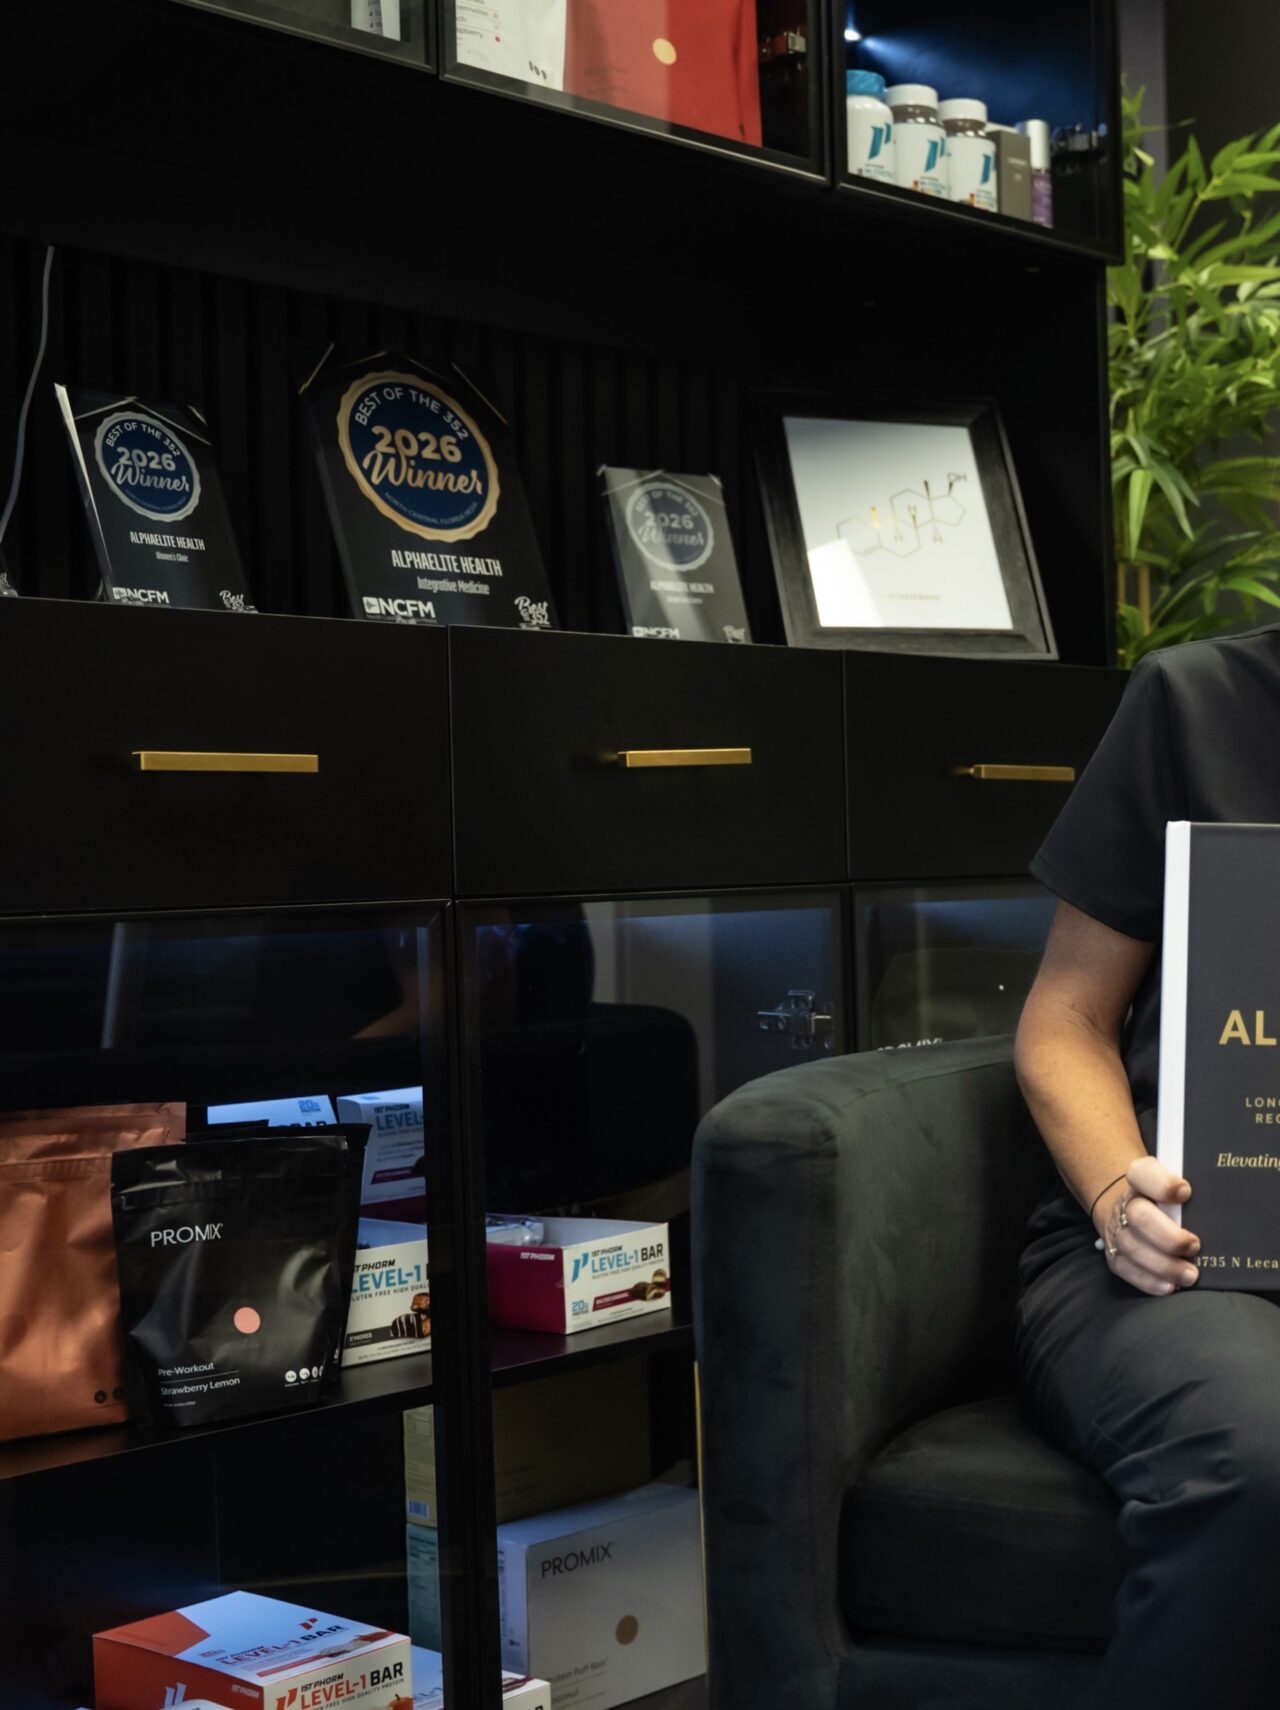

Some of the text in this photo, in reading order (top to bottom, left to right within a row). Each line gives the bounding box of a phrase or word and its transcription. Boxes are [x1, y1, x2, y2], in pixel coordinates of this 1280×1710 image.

[354, 387, 469, 441] BEST OF THE 352
[105, 421, 181, 457] BEST OF THE 352
[371, 424, 463, 463] 2026
[116, 446, 177, 472] 2026
[110, 462, 190, 493] Winner
[362, 450, 483, 495] Winner
[644, 511, 695, 531] 2026
[129, 531, 206, 551] ALPHAELITE HEALTH
[391, 549, 504, 577] ALPHAELITE HEALTH
[416, 576, 490, 595] Integrative Medicine
[126, 590, 170, 604] NCFM
[378, 597, 436, 618] NCFM
[150, 1224, 222, 1248] PROMIX
[361, 1259, 396, 1272] PHORM
[591, 1243, 664, 1273] LEVEL-1 BAR
[1231, 1256, 1240, 1268] N
[157, 1362, 215, 1378] Pre-Workout
[161, 1377, 241, 1396] Strawberry Lemon
[541, 1545, 613, 1579] PROMIX
[300, 1625, 345, 1642] BAR
[301, 1672, 344, 1693] 1ST PHORM
[301, 1661, 403, 1710] LEVEL-1 BAR
